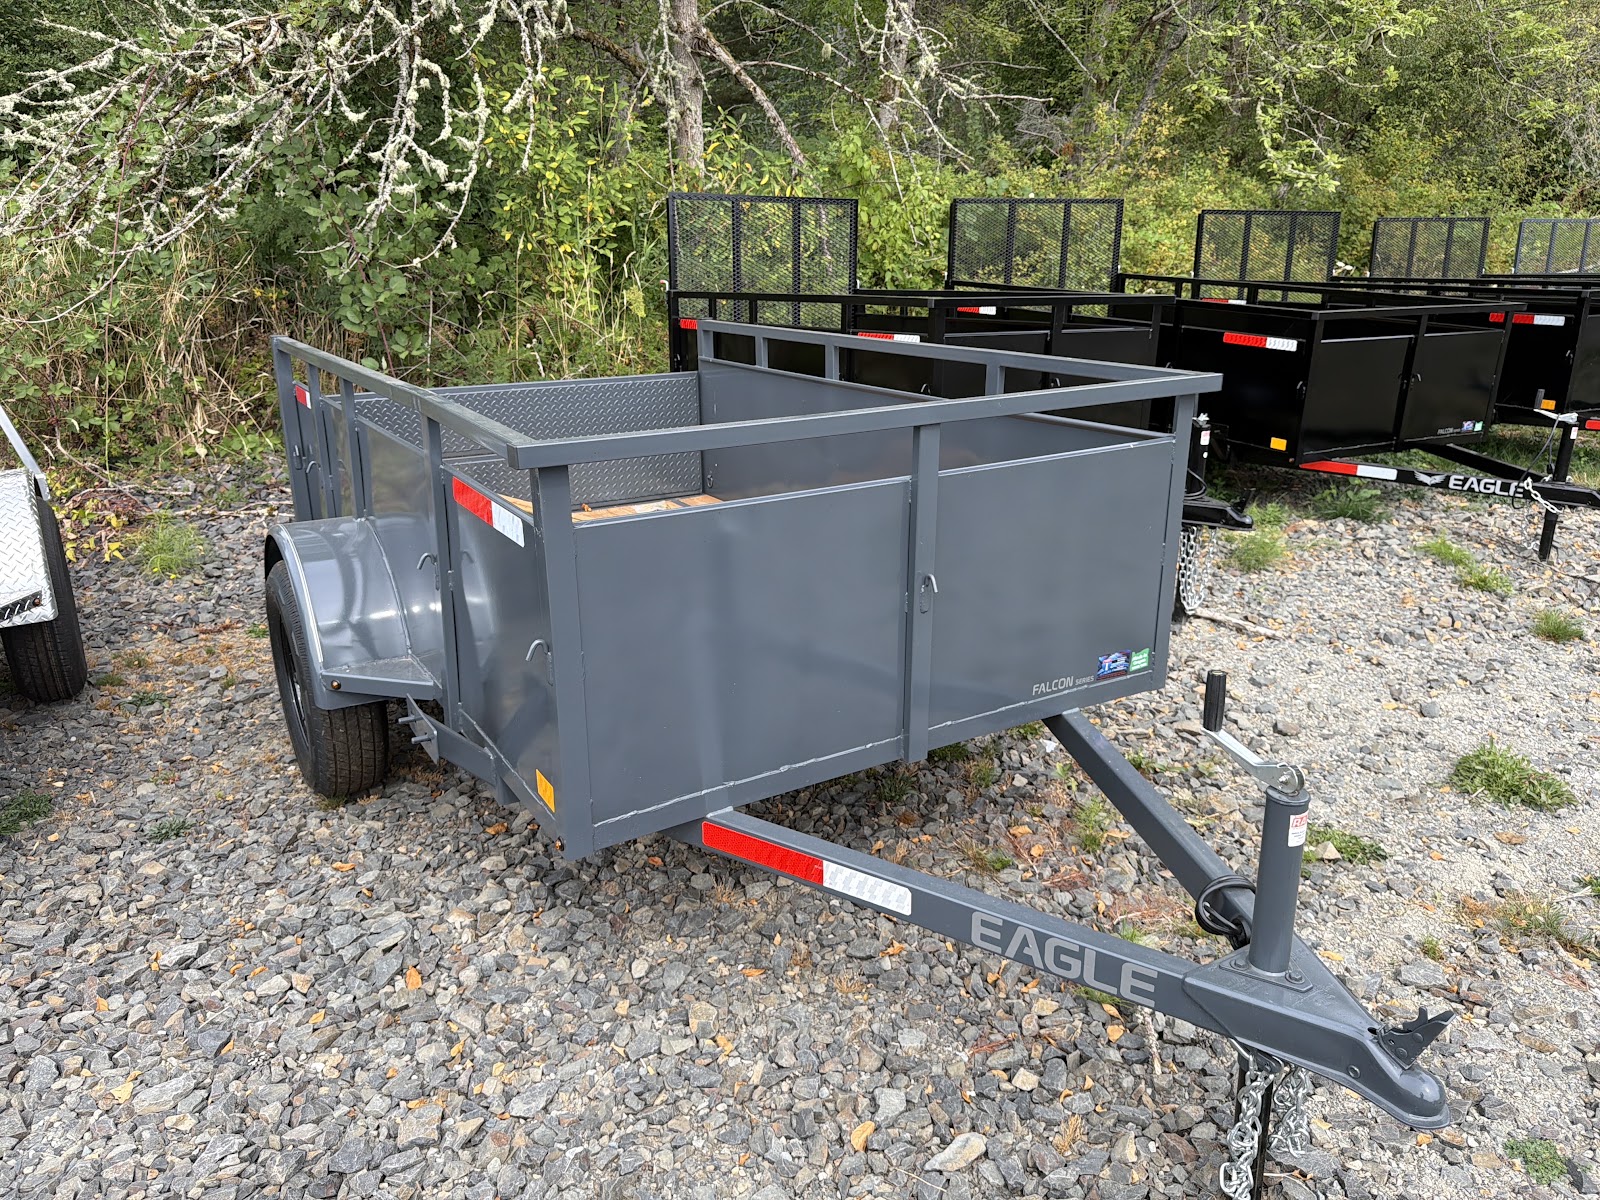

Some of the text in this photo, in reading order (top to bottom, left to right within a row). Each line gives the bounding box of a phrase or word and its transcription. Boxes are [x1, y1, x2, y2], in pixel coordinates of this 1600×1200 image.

[1448, 474, 1525, 498] EAGLE
[1032, 675, 1095, 696] FALCON SERIES
[971, 911, 1158, 1008] EAGLE
